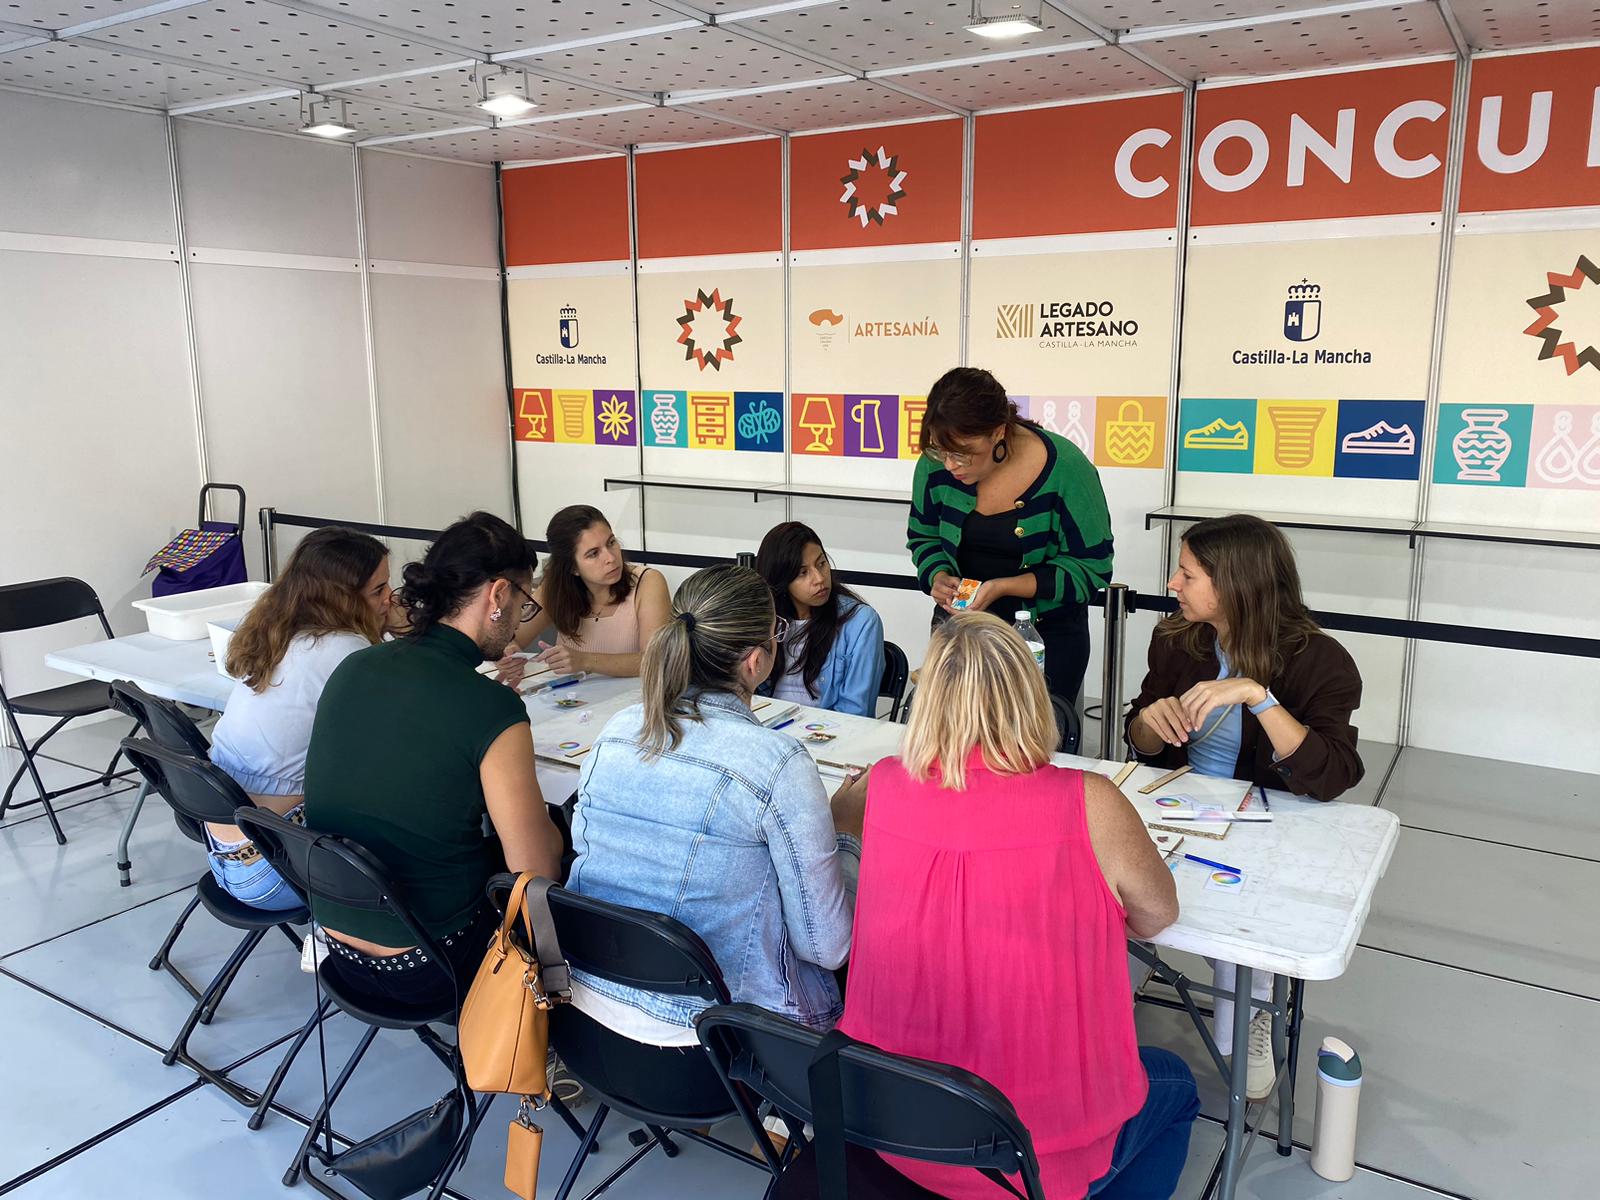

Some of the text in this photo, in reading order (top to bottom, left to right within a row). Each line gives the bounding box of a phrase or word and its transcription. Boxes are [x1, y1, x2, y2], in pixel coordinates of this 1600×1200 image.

[1114, 86, 1600, 198] CONCU
[1040, 301, 1114, 319] LEGADO
[854, 316, 939, 337] ARTESANÍA
[1040, 320, 1139, 338] ARTESANO
[1097, 339, 1138, 348] MANCHA
[535, 353, 607, 365] Castilla-La Mancha
[1232, 348, 1372, 365] Castilla-La Mancha
